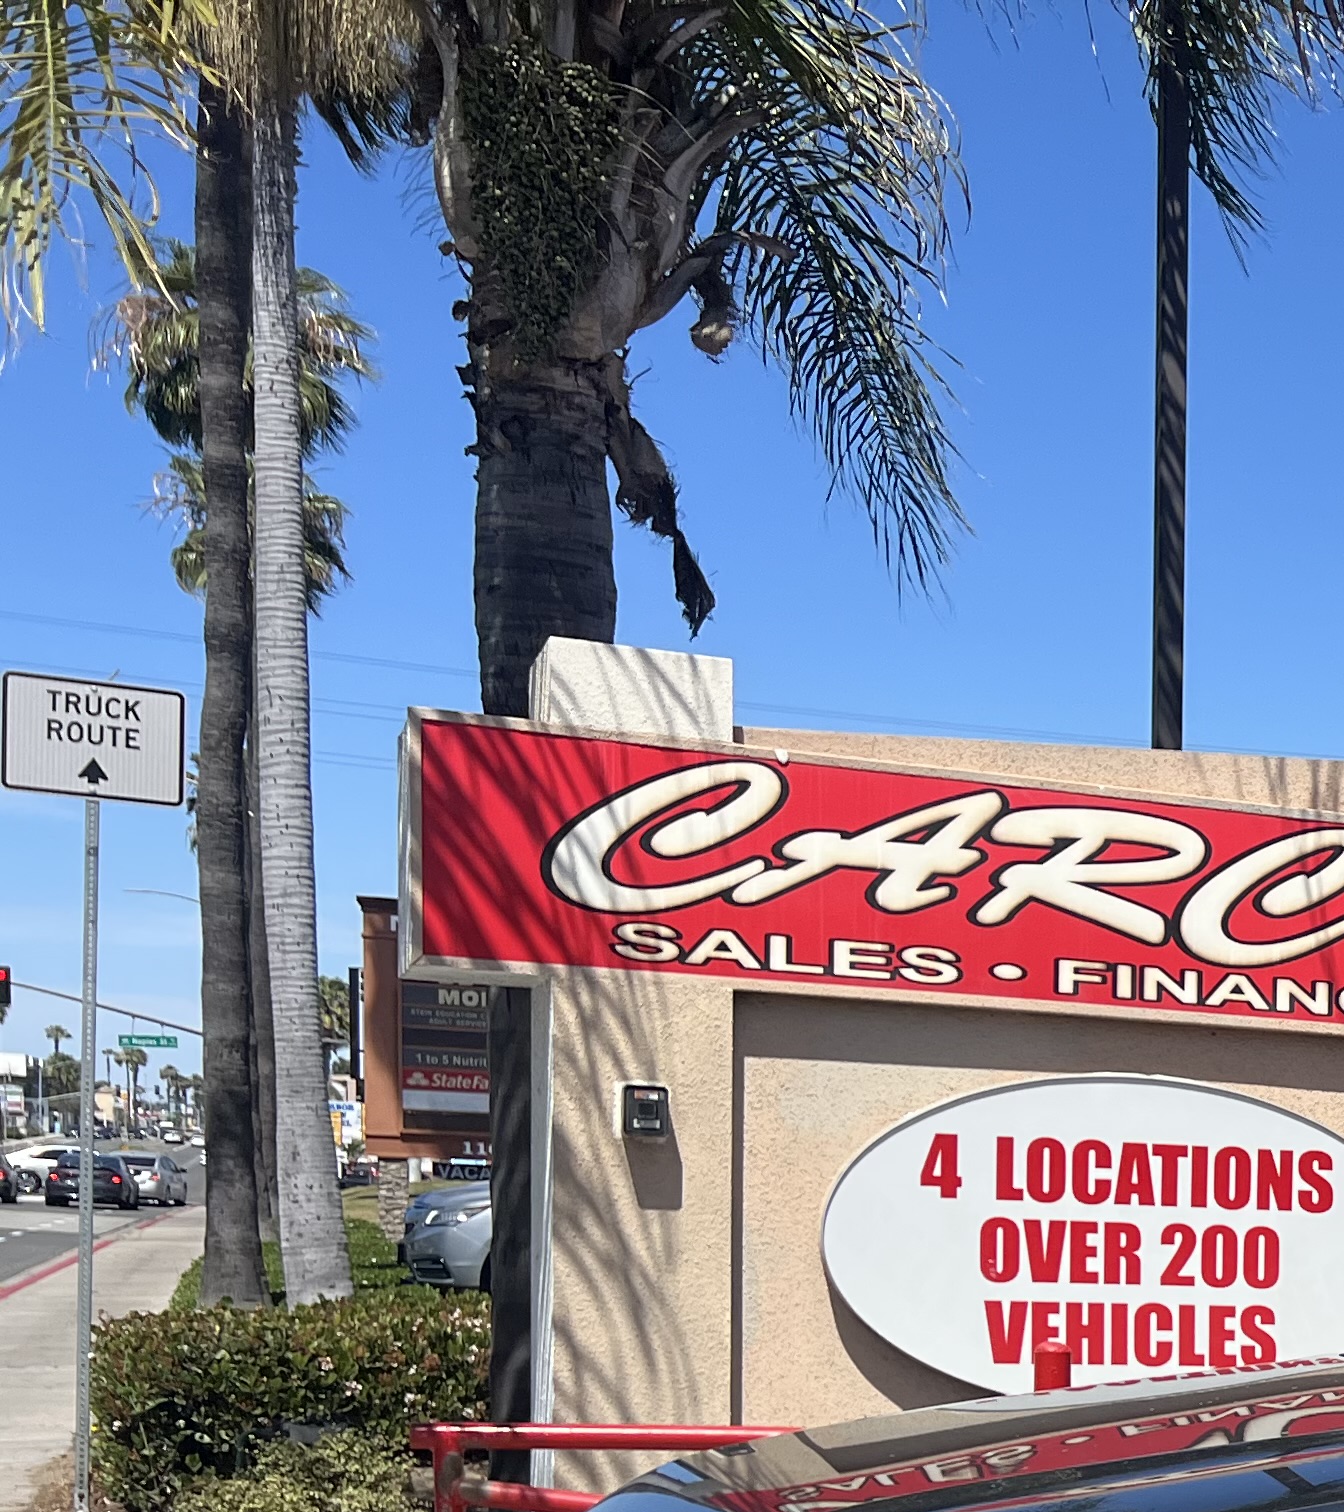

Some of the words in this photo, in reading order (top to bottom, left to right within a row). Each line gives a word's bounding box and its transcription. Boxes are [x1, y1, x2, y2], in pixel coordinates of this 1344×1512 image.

[46, 689, 141, 722] TRUCK
[46, 717, 141, 751] ROUTE
[613, 921, 960, 985] SALES
[416, 1053, 422, 1063] 1
[426, 1054, 438, 1064] to
[919, 1132, 963, 1200] 4
[995, 1135, 1335, 1215] LOCATIONS
[979, 1216, 1143, 1286] OVER
[1159, 1222, 1281, 1290] 200
[983, 1299, 1278, 1369] VEHICLES
